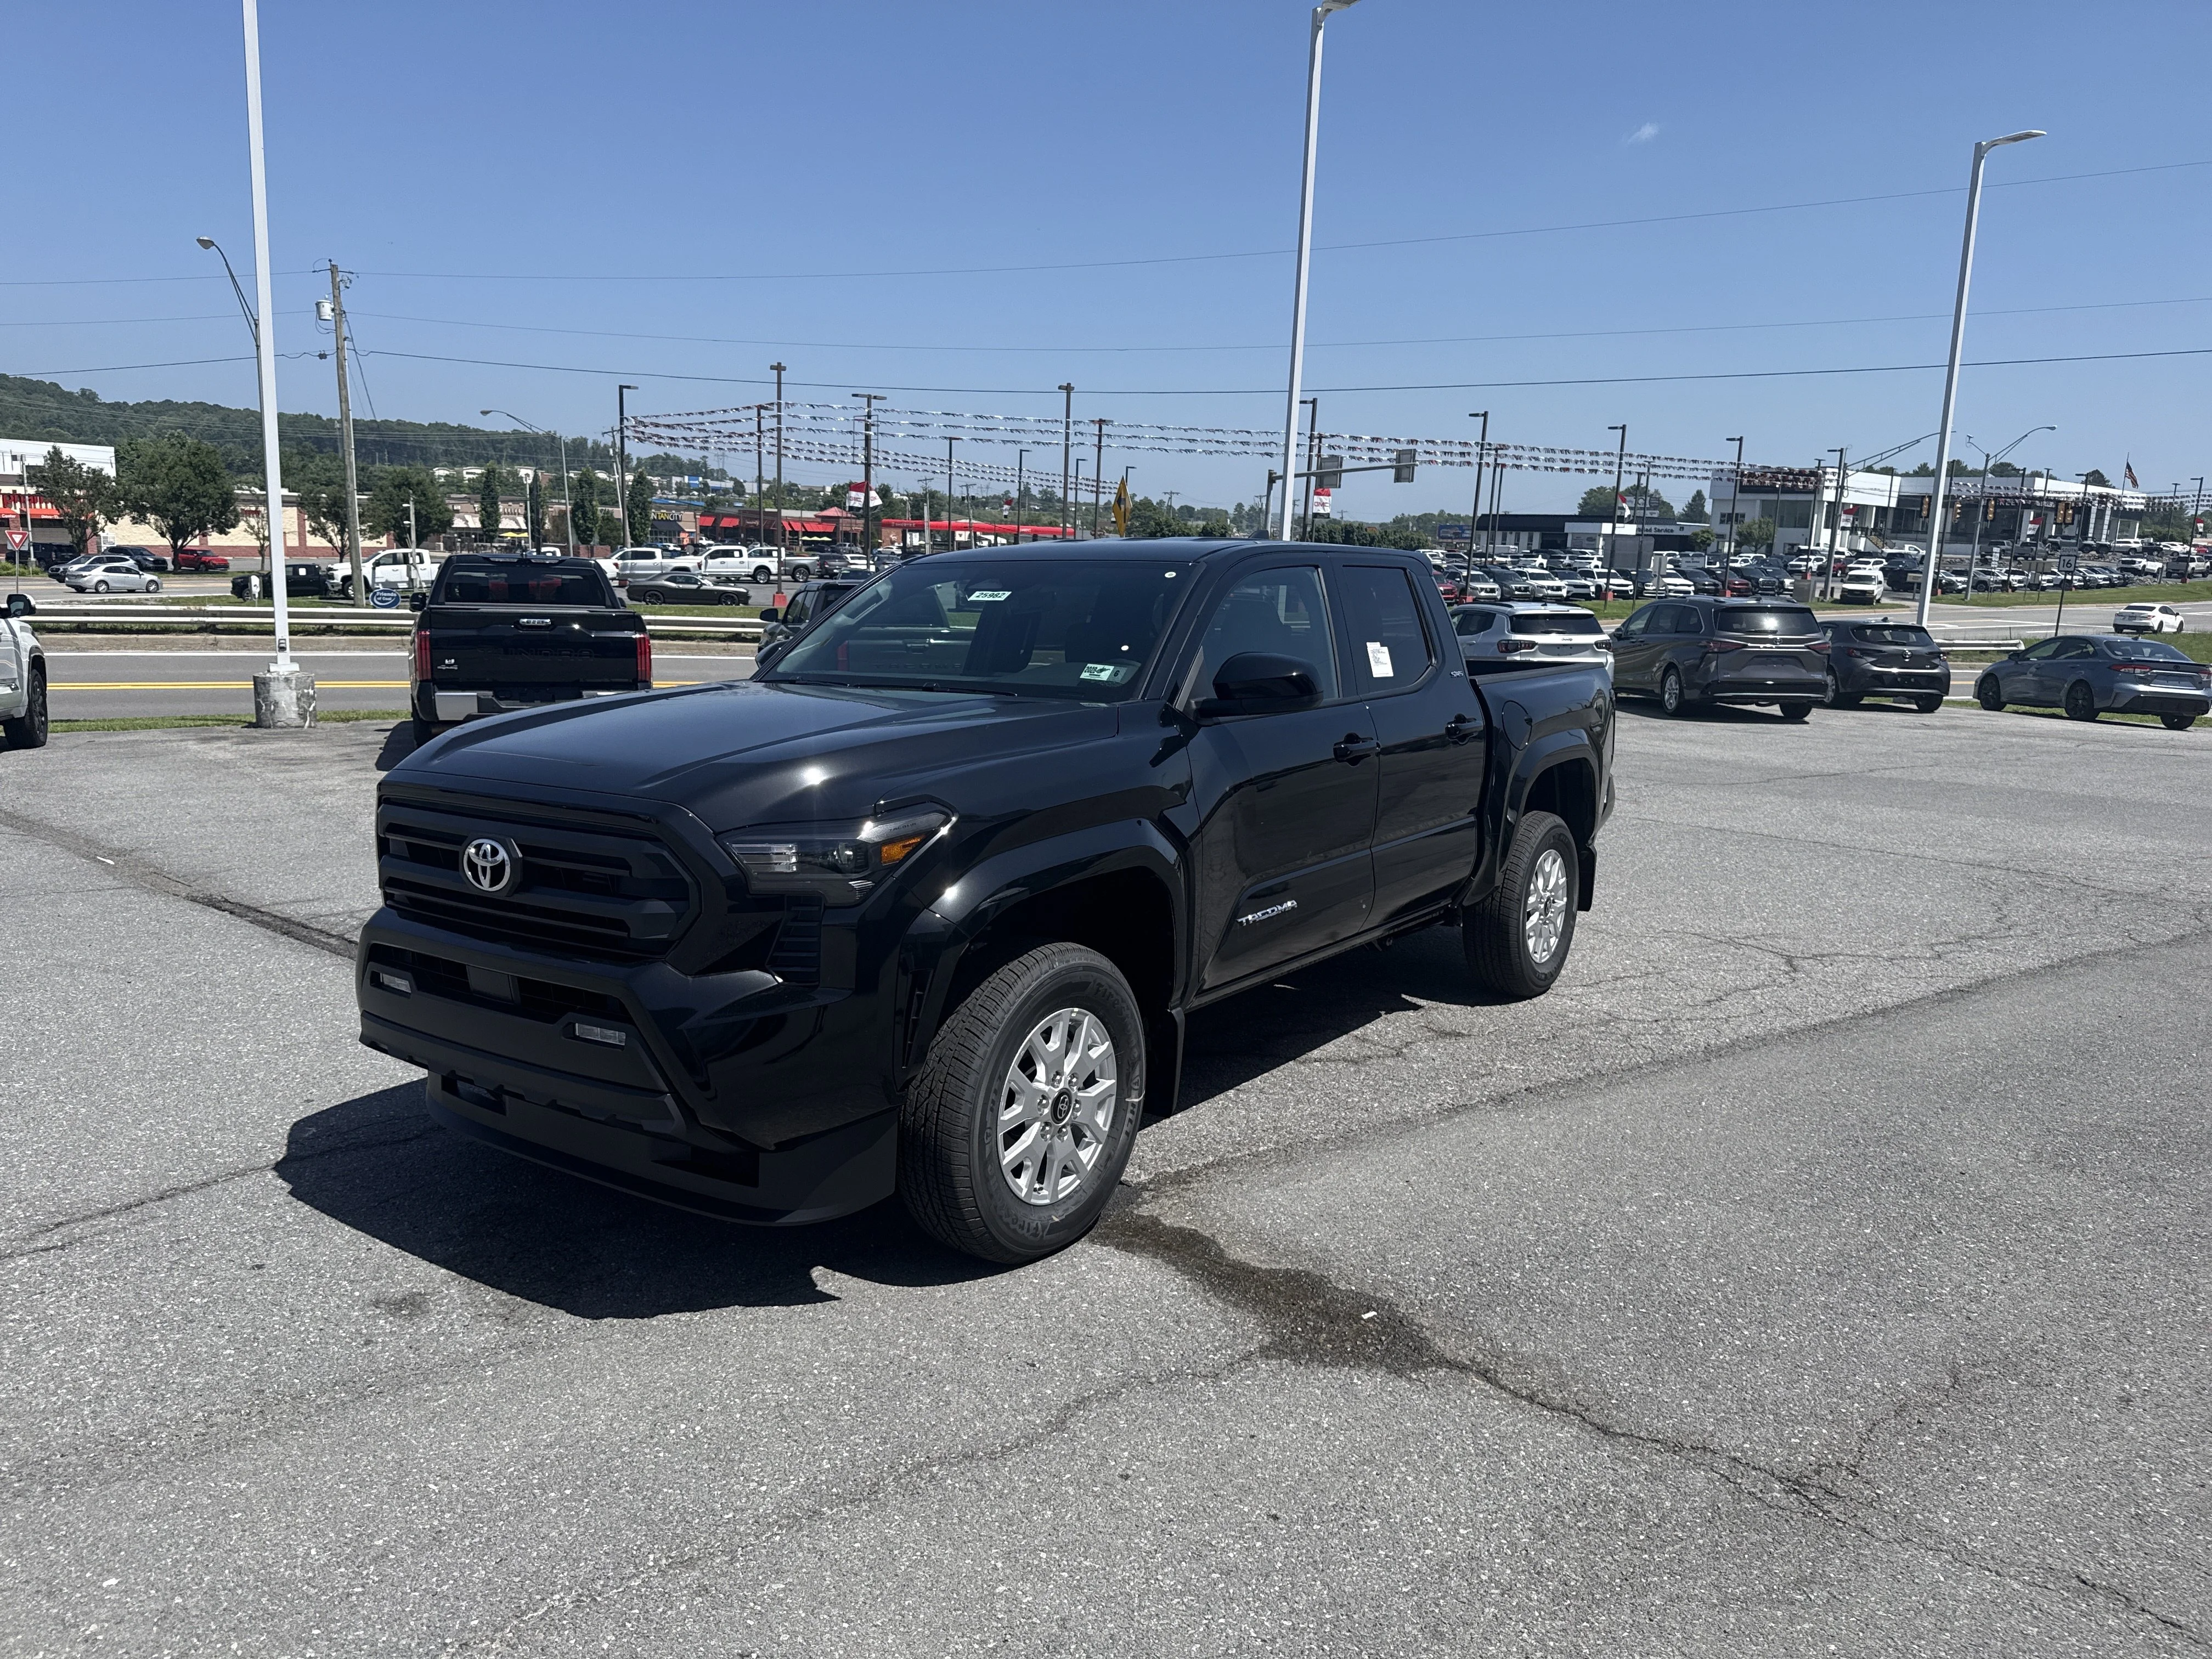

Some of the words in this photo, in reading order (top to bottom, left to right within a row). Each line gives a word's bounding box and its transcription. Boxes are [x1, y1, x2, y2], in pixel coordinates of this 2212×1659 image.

[2063, 559, 2072, 568] 16
[889, 822, 917, 832] TACOMA
[1235, 900, 1297, 926] TACOMA
